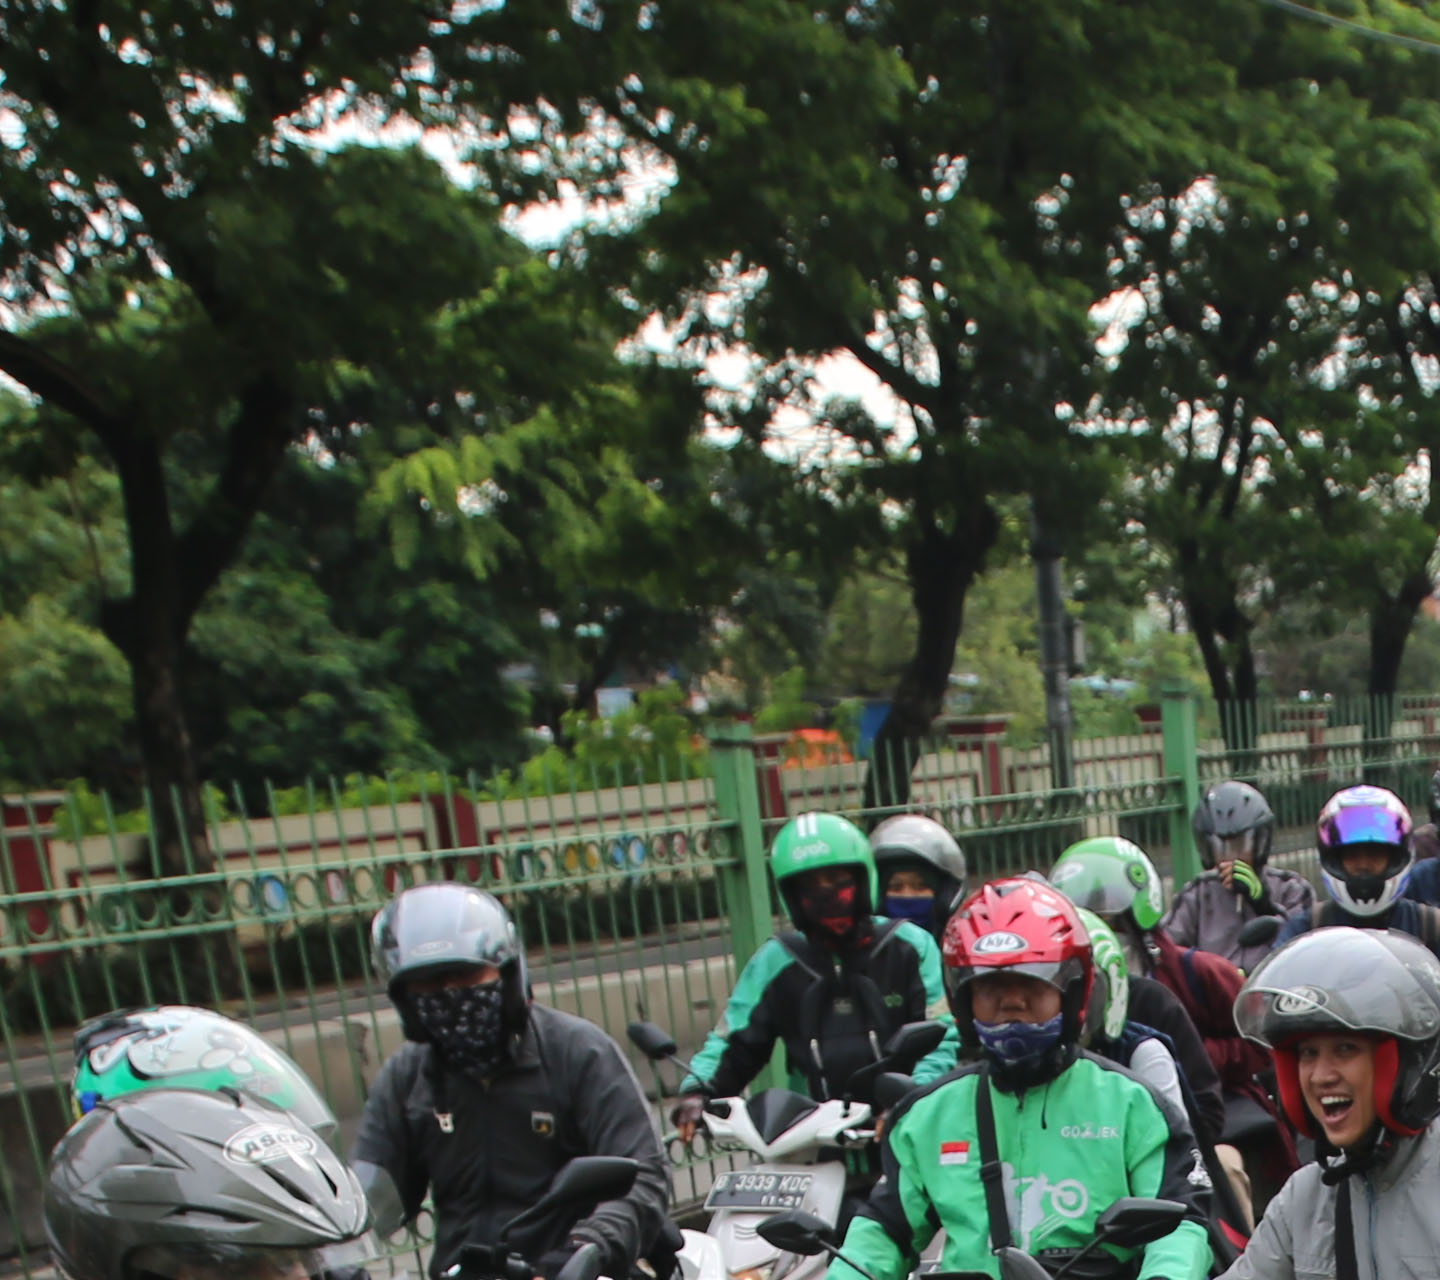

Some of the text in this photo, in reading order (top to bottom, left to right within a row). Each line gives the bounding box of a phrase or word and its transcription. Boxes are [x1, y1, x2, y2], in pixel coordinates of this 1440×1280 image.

[792, 840, 831, 862] Grab
[716, 1175, 729, 1191] B
[735, 1175, 775, 1191] 3939
